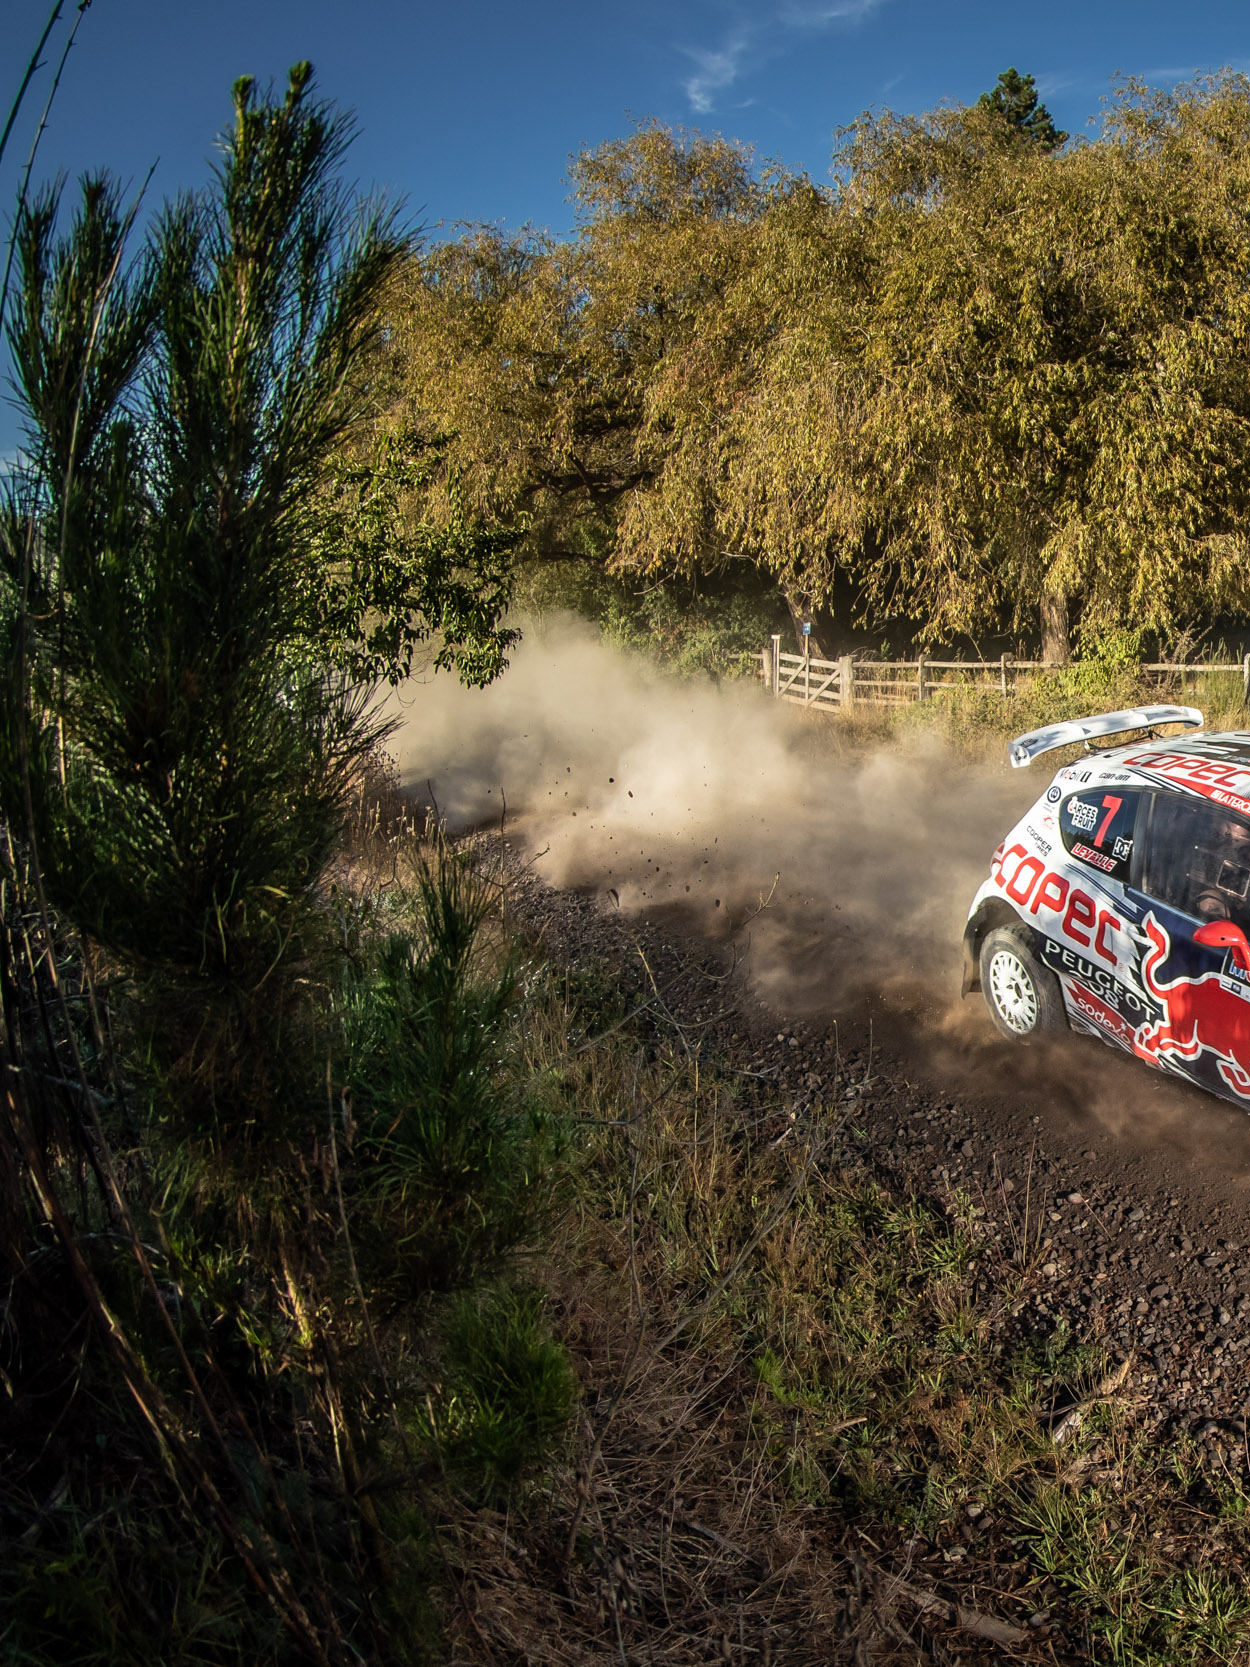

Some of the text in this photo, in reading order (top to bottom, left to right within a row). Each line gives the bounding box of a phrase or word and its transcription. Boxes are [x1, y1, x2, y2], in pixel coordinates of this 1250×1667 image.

[1026, 825, 1052, 852] COOPER
[1074, 814, 1094, 831] FRUIT
[1094, 795, 1123, 847] 7
[1072, 843, 1117, 871] LEVALLE
[1046, 939, 1155, 1021] PEUGEOT
[1077, 997, 1131, 1044] sodexo
